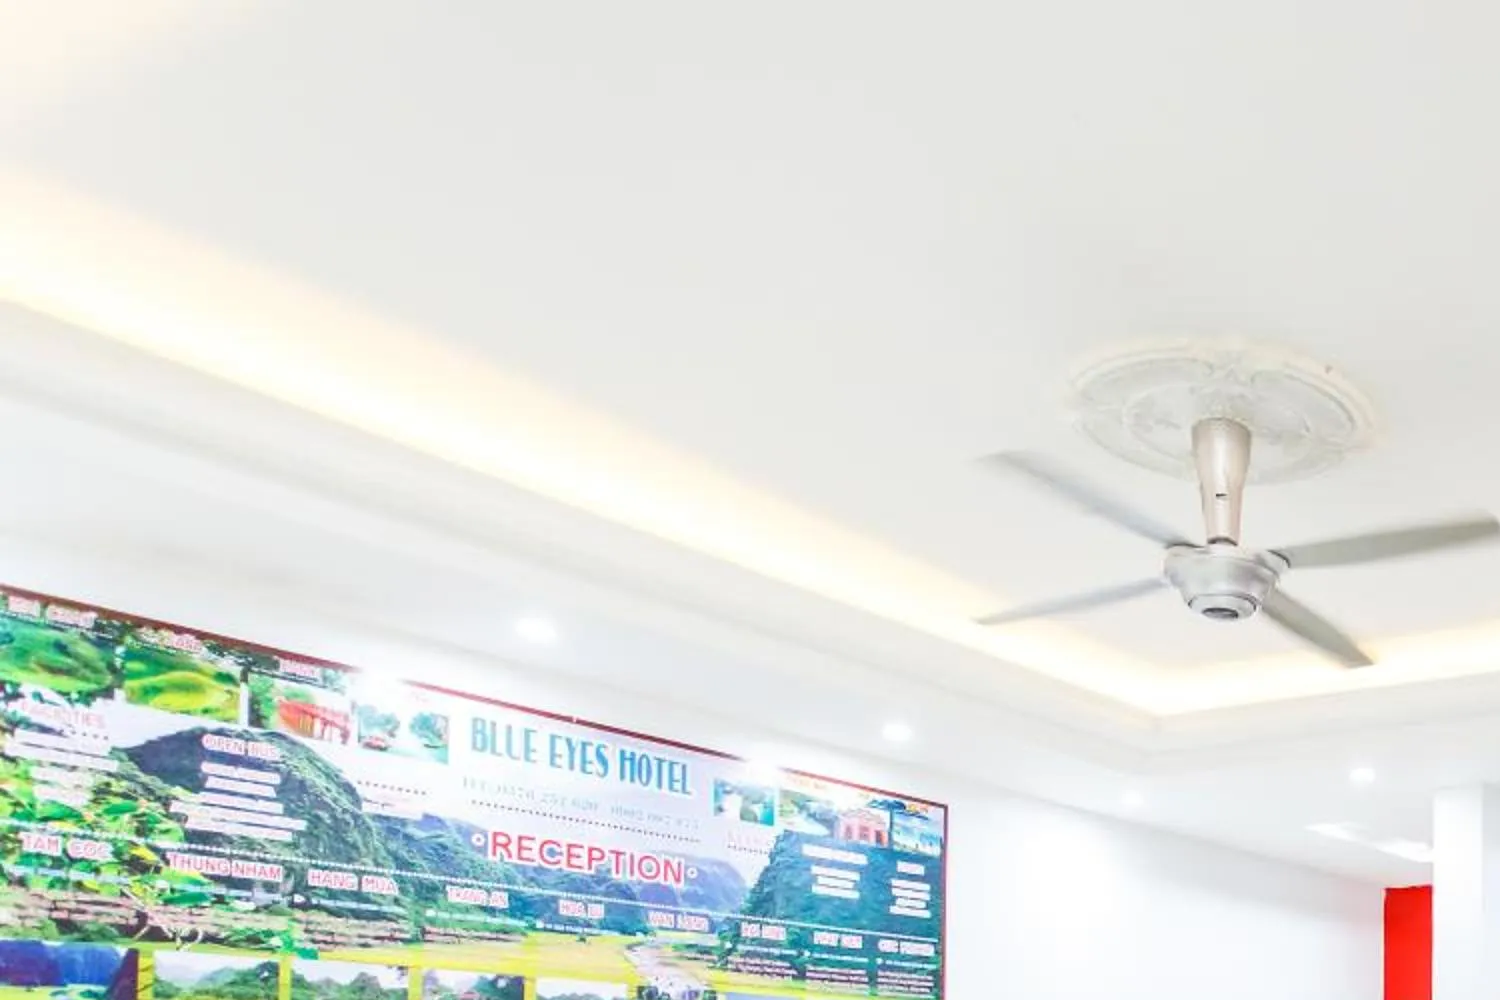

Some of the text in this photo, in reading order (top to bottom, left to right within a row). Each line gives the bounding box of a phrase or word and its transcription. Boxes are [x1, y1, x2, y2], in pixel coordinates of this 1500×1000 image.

[549, 733, 610, 778] EYES
[619, 749, 693, 796] HOTEL
[490, 830, 683, 885] RECEPTION
